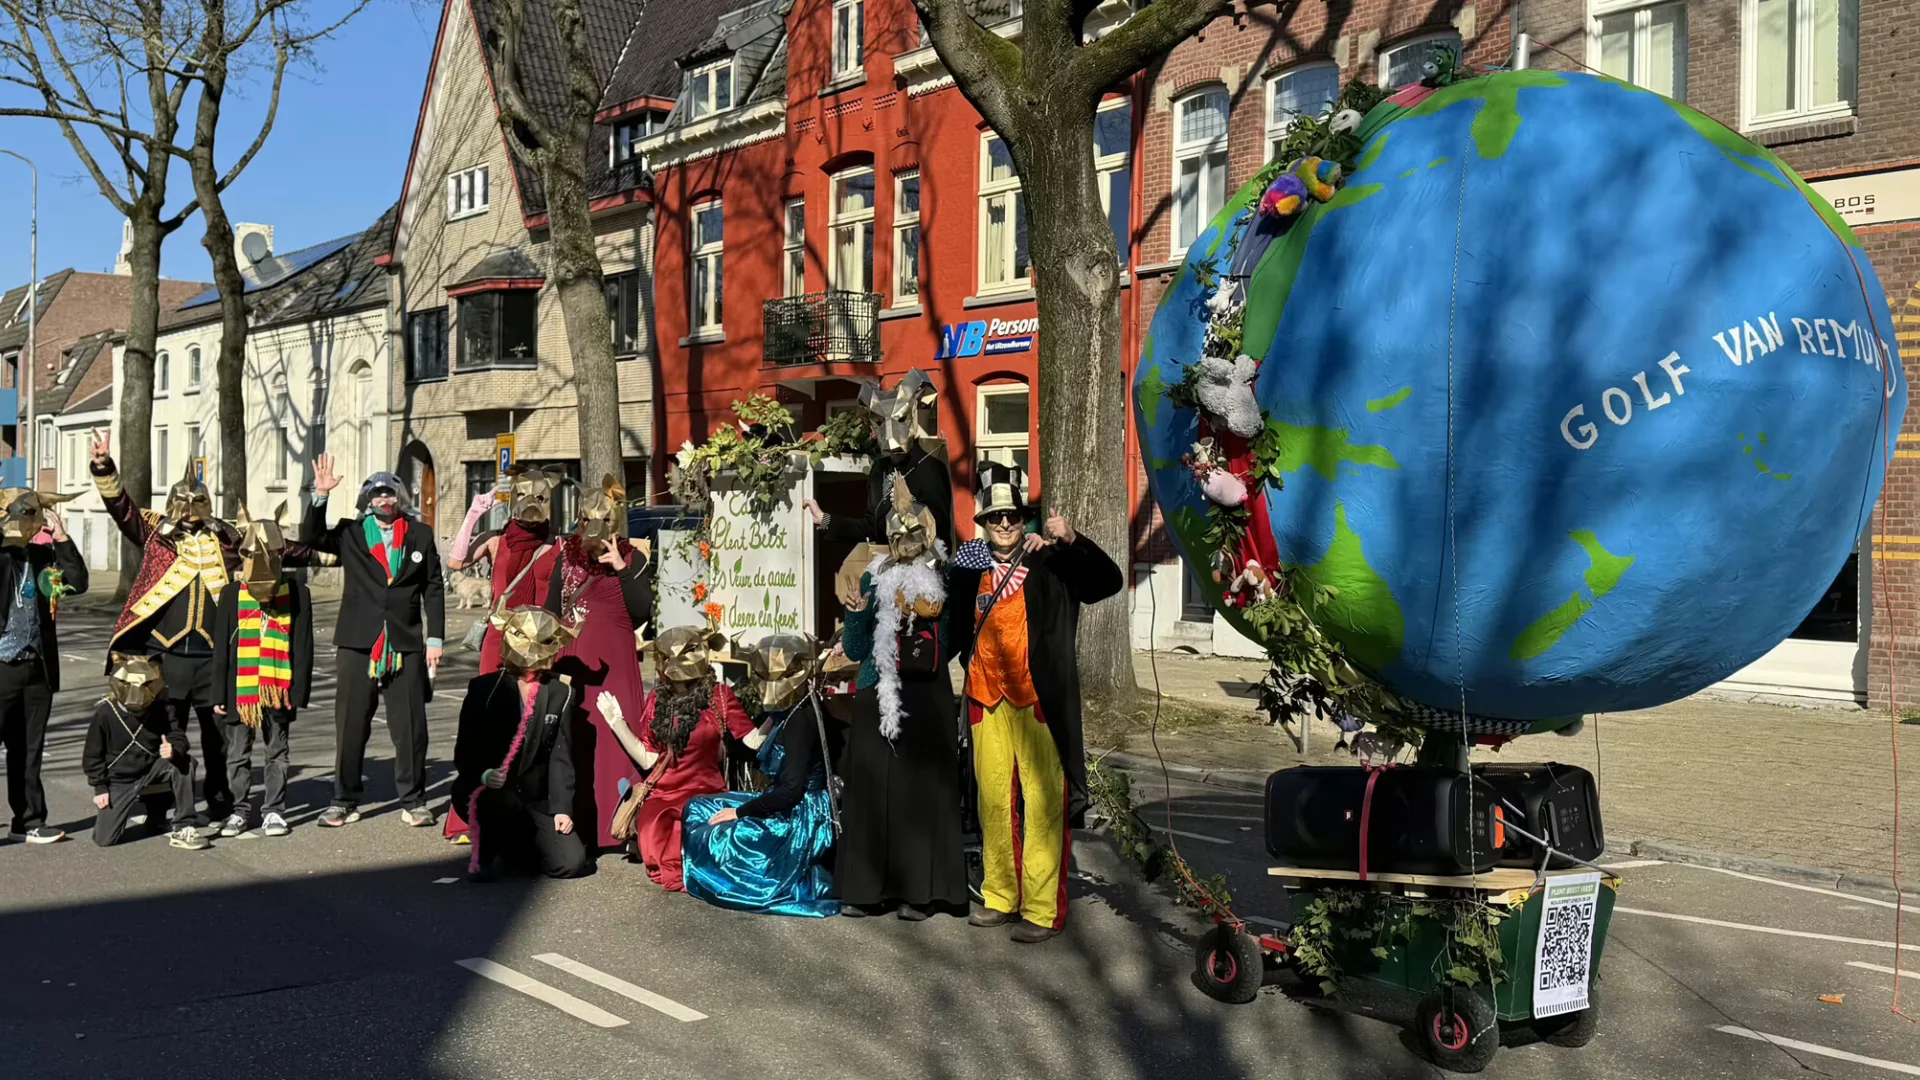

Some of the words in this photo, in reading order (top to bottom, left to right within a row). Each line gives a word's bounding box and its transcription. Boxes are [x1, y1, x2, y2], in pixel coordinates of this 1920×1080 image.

[1834, 194, 1875, 209] BOS
[988, 318, 1040, 338] Person
[1559, 351, 1691, 450] GOLF
[1712, 311, 1785, 367] VAN
[754, 566, 767, 587] de
